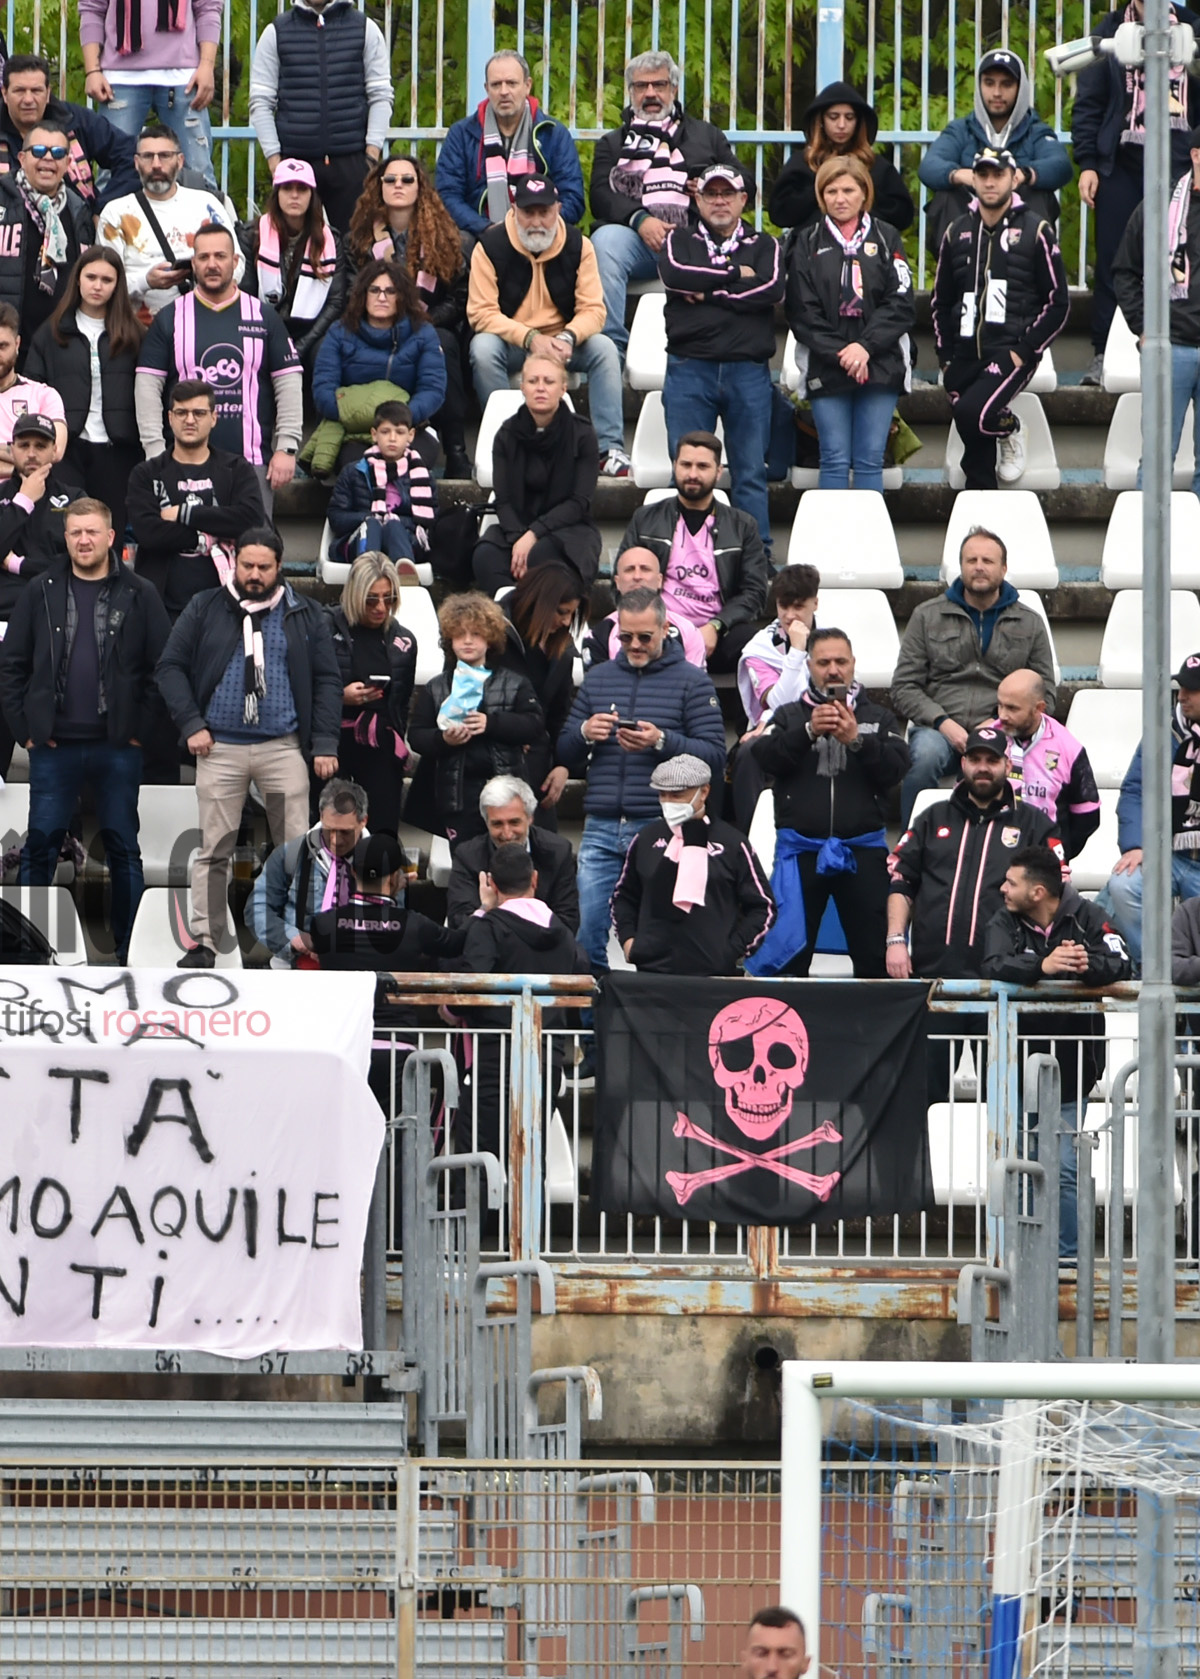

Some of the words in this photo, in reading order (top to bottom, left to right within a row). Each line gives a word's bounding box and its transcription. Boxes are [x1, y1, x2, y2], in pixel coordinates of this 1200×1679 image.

[338, 918, 401, 931] PALERMO
[155, 1350, 182, 1373] 56
[259, 1353, 289, 1375] 57
[346, 1353, 374, 1375] 58
